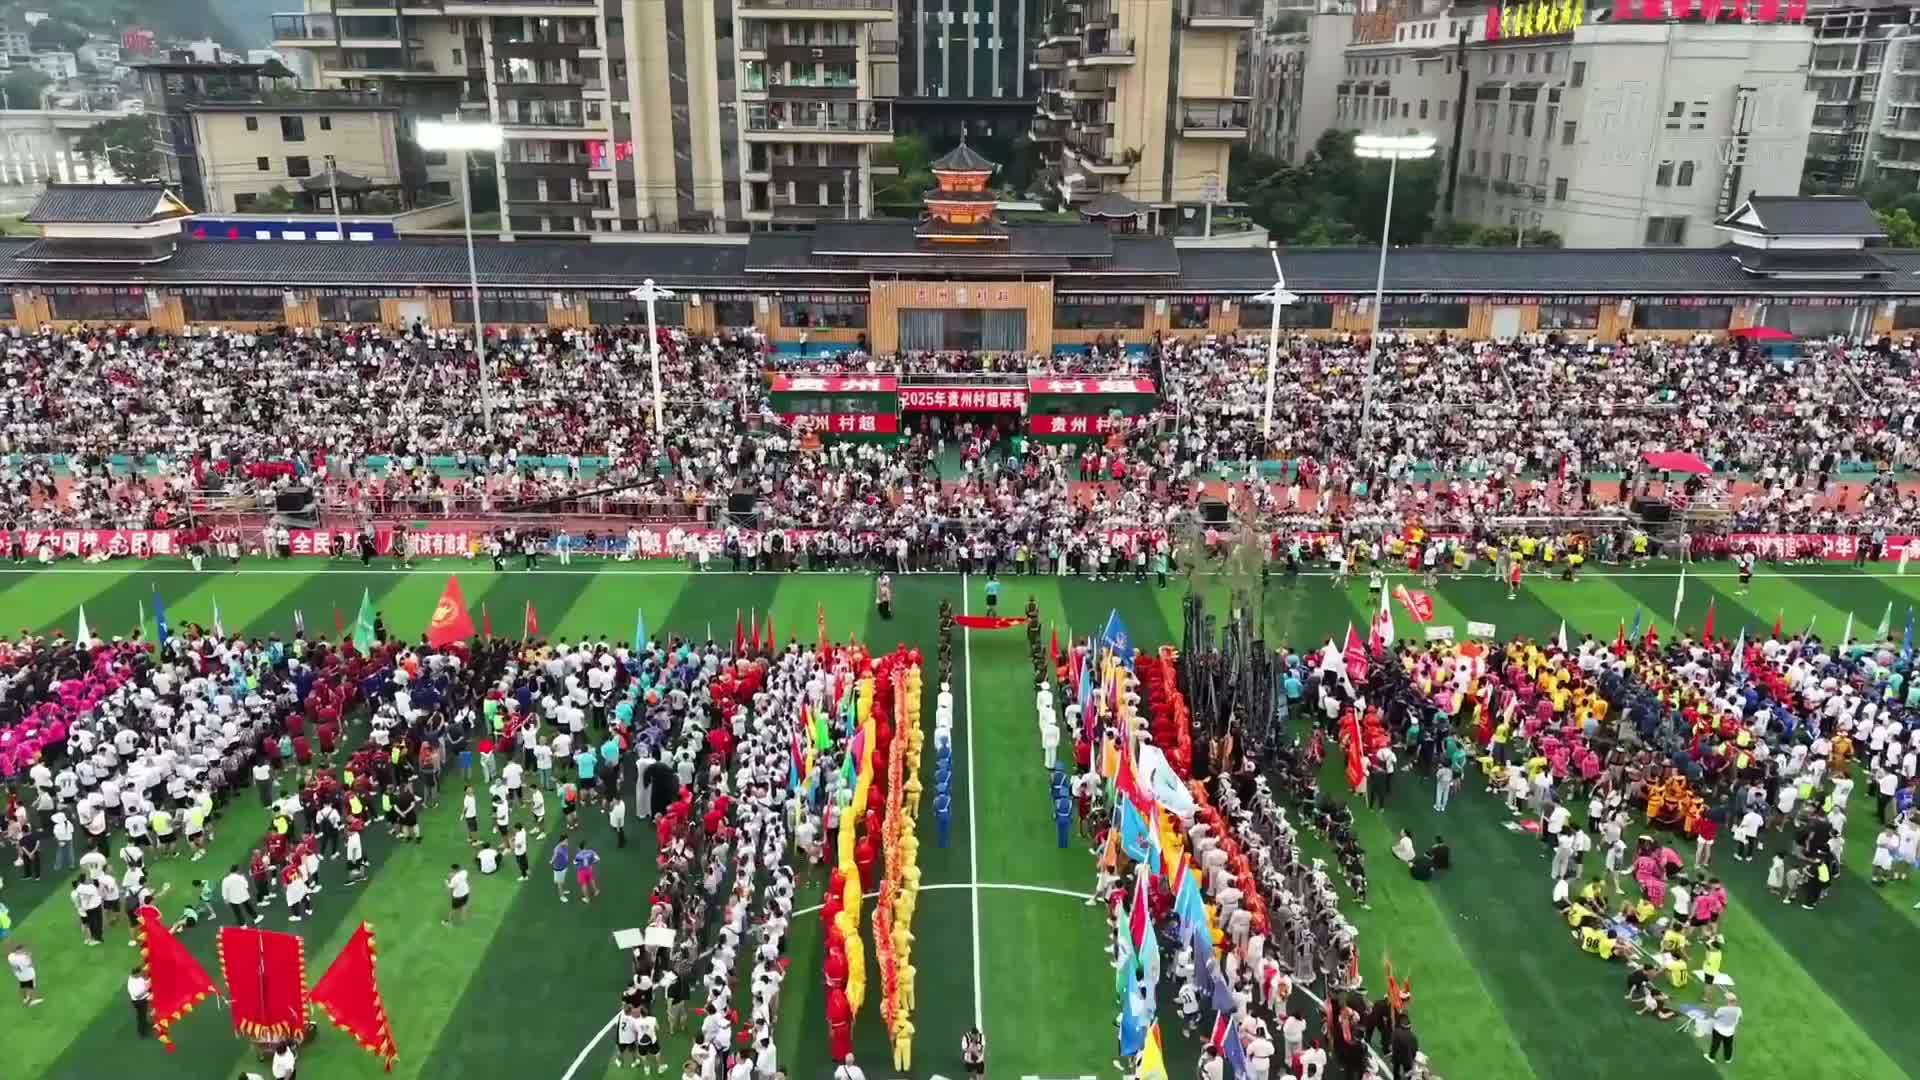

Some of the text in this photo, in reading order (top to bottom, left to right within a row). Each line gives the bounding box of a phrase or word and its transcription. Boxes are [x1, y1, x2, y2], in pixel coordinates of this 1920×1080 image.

[902, 391, 1025, 408] 2025年贵州村超联赛
